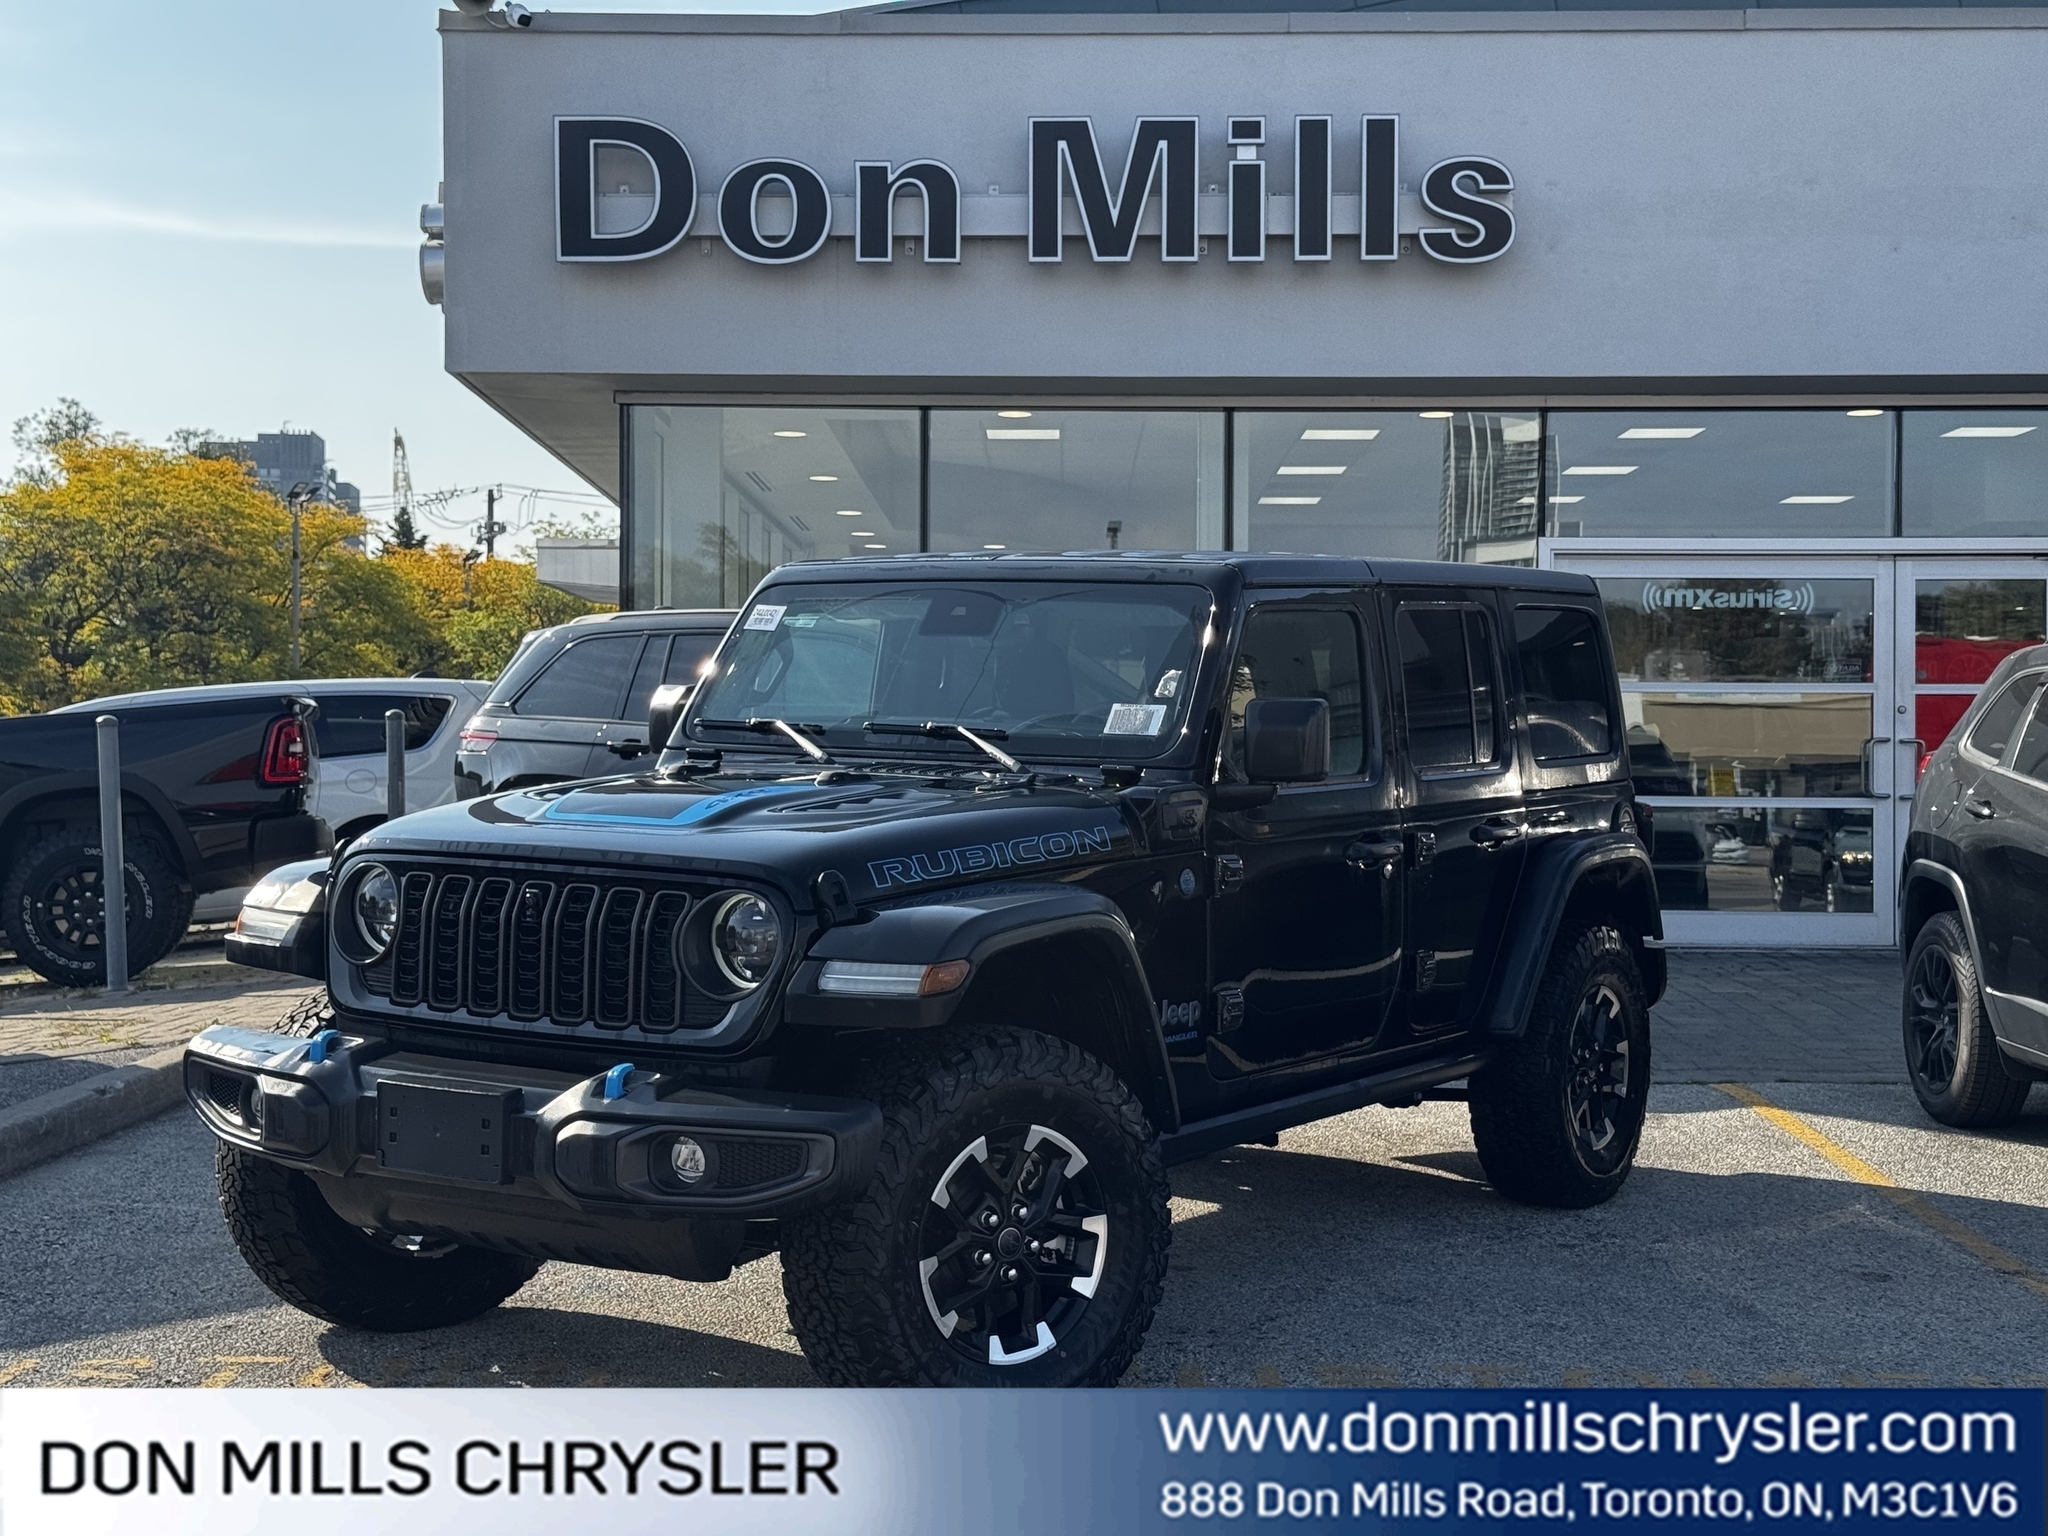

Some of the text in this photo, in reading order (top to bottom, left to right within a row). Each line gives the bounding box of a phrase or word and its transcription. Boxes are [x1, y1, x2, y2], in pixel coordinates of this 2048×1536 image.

[553, 113, 1517, 264] Don Mills
[867, 826, 1112, 888] RUBICON
[1160, 999, 1201, 1027] Jeep
[1165, 1031, 1198, 1043] ANGLER
